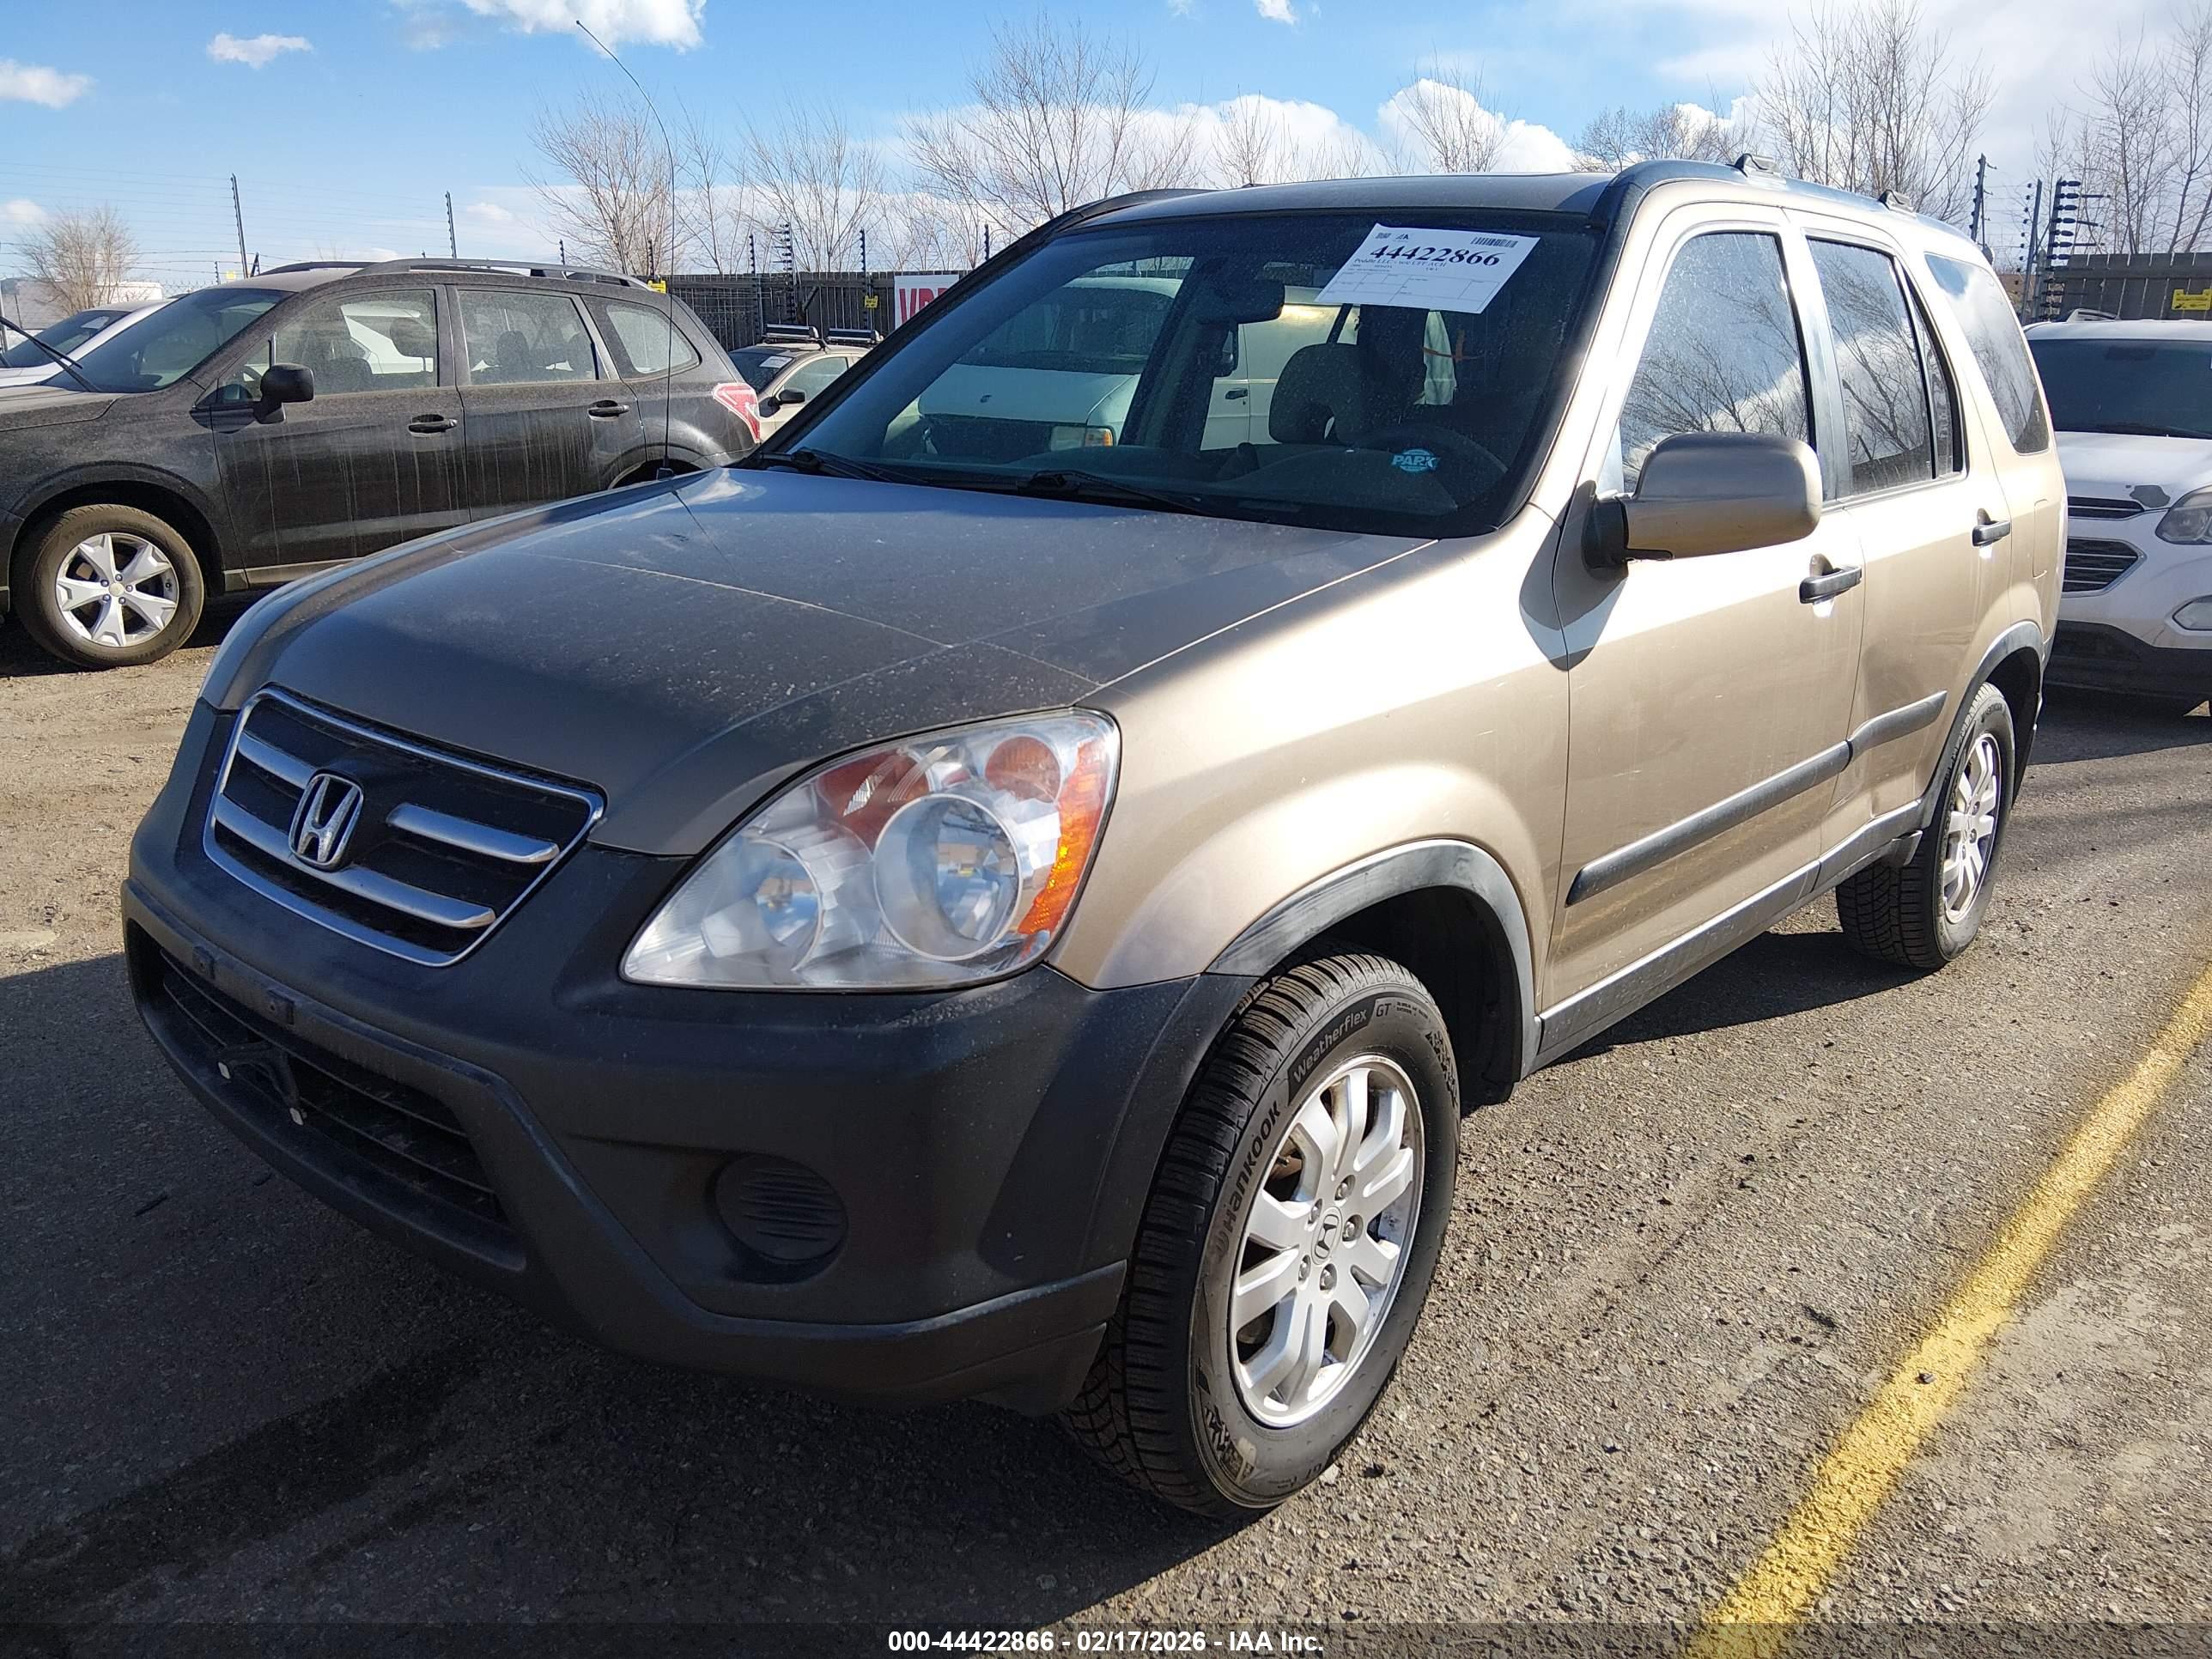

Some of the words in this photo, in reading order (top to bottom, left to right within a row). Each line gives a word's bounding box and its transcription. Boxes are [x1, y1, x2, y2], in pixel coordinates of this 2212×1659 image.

[1370, 245, 1505, 266] 44422866
[1293, 1009, 1367, 1083] Weatherflex
[1376, 1003, 1391, 1017] GT
